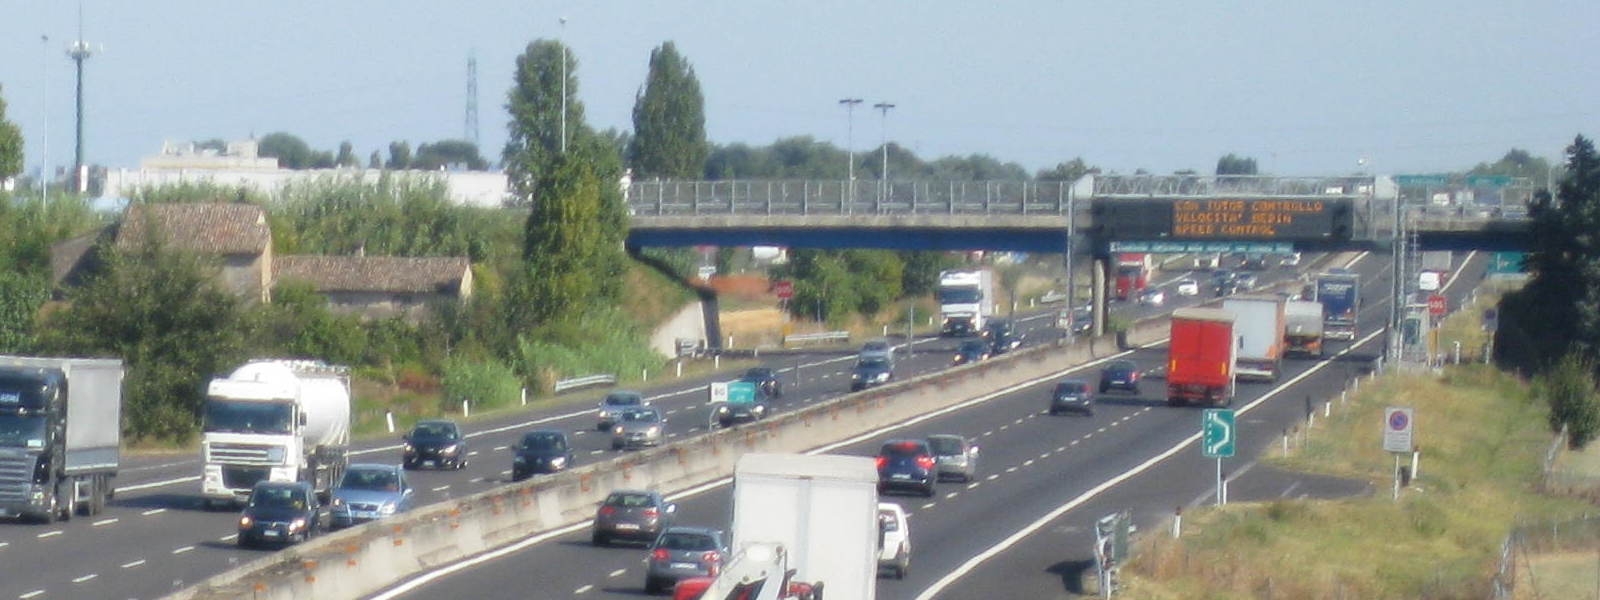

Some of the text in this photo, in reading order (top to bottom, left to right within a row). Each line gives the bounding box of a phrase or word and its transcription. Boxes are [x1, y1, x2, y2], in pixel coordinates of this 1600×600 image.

[1174, 201, 1323, 212] CON TUTOR CONTROLLO
[1174, 224, 1275, 235] SPEED CONTROL
